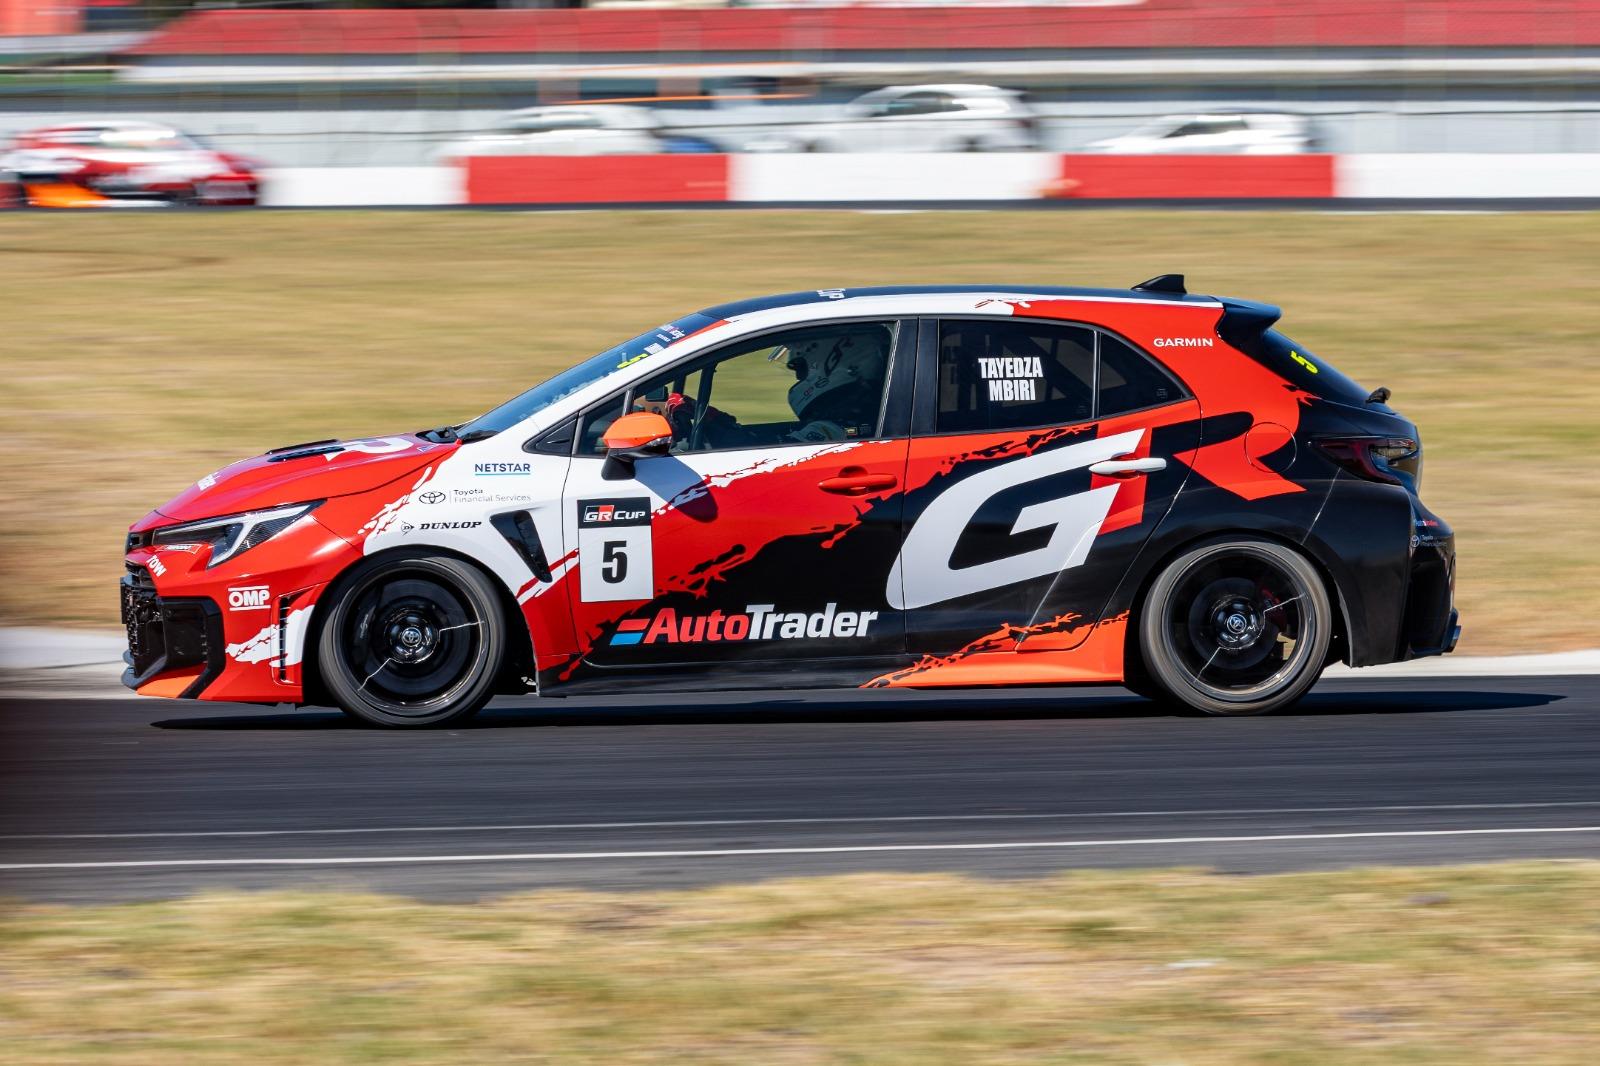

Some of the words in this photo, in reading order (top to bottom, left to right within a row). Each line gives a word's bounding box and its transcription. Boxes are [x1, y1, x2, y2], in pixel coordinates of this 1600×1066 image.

[1153, 337, 1214, 348] GARMIN
[978, 356, 1044, 379] TAYEDZA
[988, 379, 1036, 401] MBIRI
[474, 463, 531, 473] NETSTAR
[453, 489, 484, 498] Toyota
[495, 494, 532, 502] Services
[420, 521, 482, 530] DUNLOP
[146, 554, 167, 577] TOW
[601, 540, 628, 584] 5
[228, 589, 270, 607] OMP
[643, 602, 878, 644] AutoTrader
